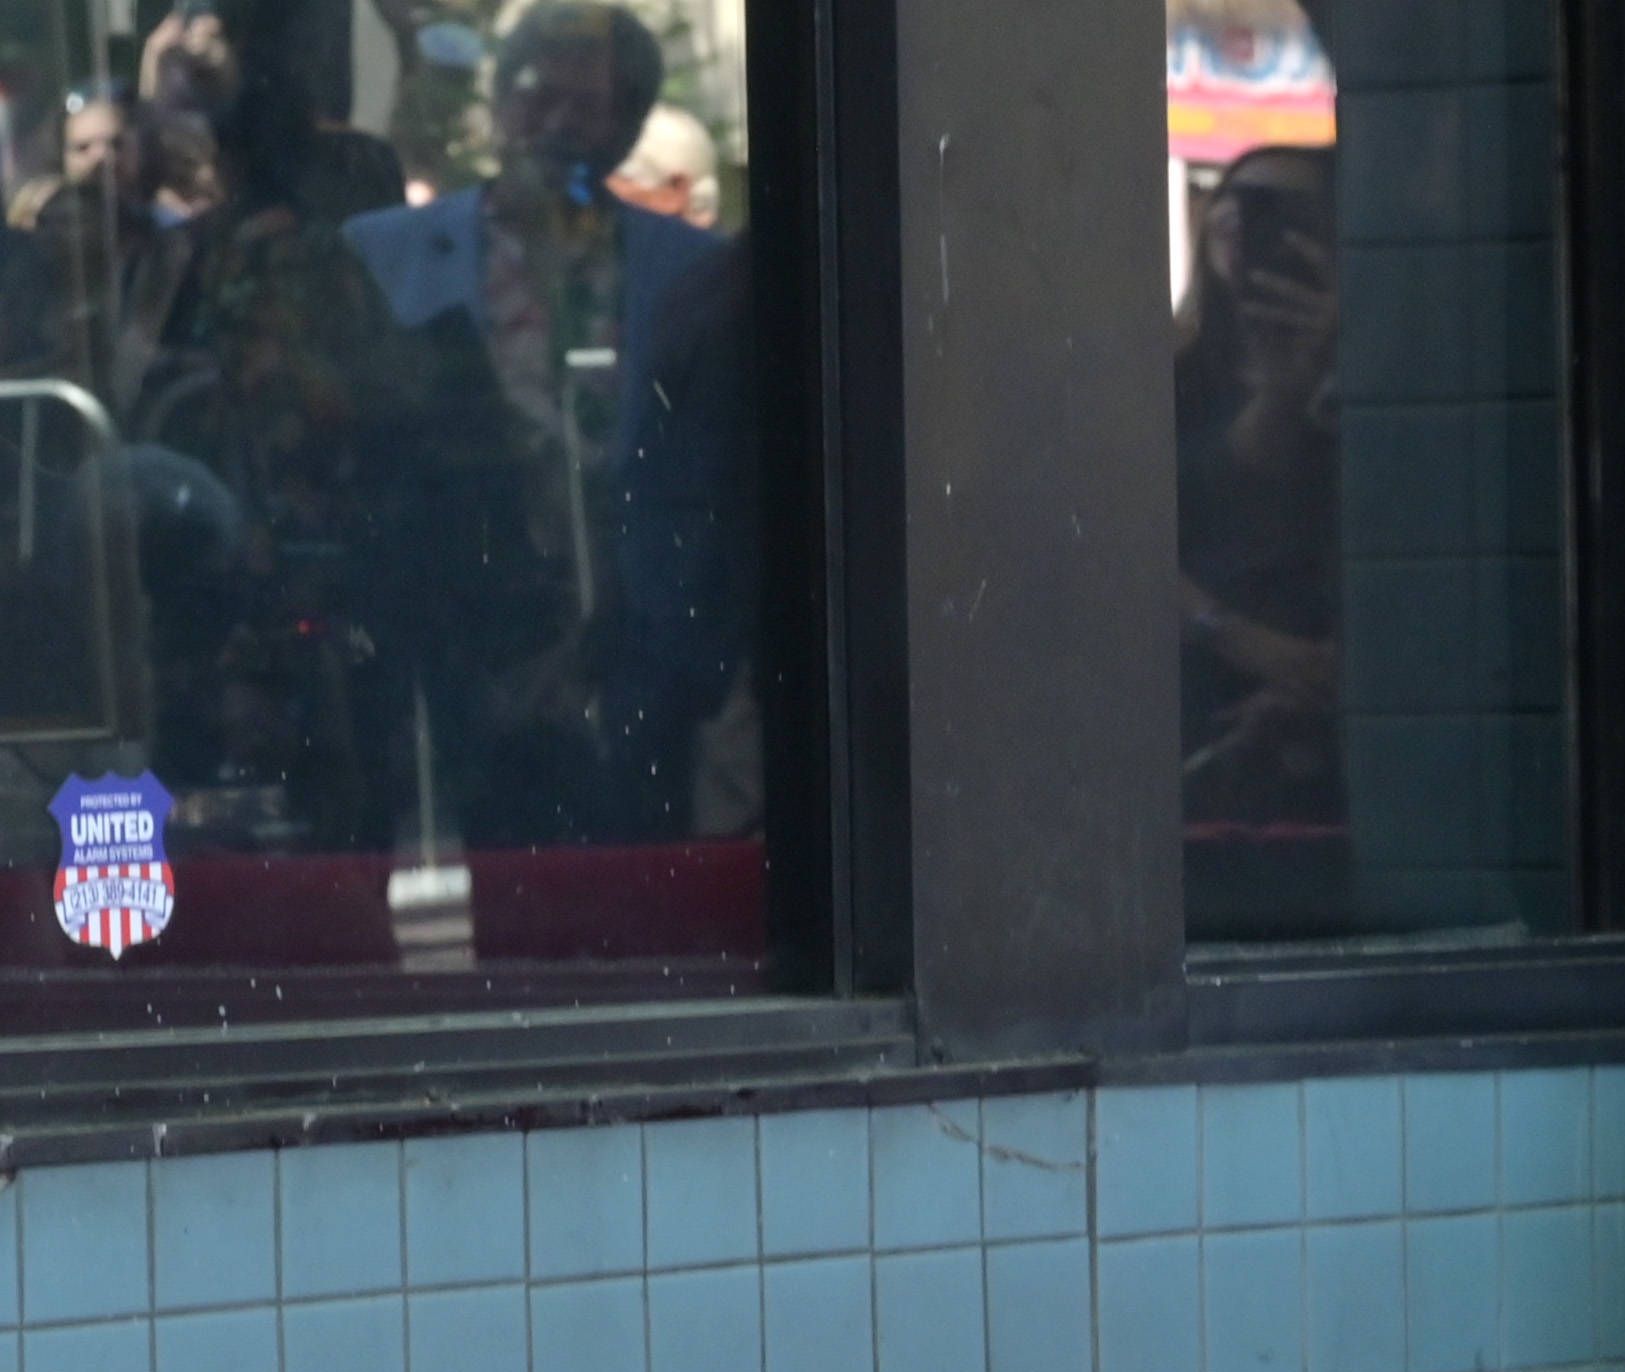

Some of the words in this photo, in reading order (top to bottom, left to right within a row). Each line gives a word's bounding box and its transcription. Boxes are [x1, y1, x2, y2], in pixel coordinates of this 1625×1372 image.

[80, 793, 129, 809] PROTECTED
[130, 792, 141, 807] BY
[71, 811, 154, 846] UNITED
[74, 847, 107, 862] ALARM
[109, 845, 153, 861] SYSTEMS
